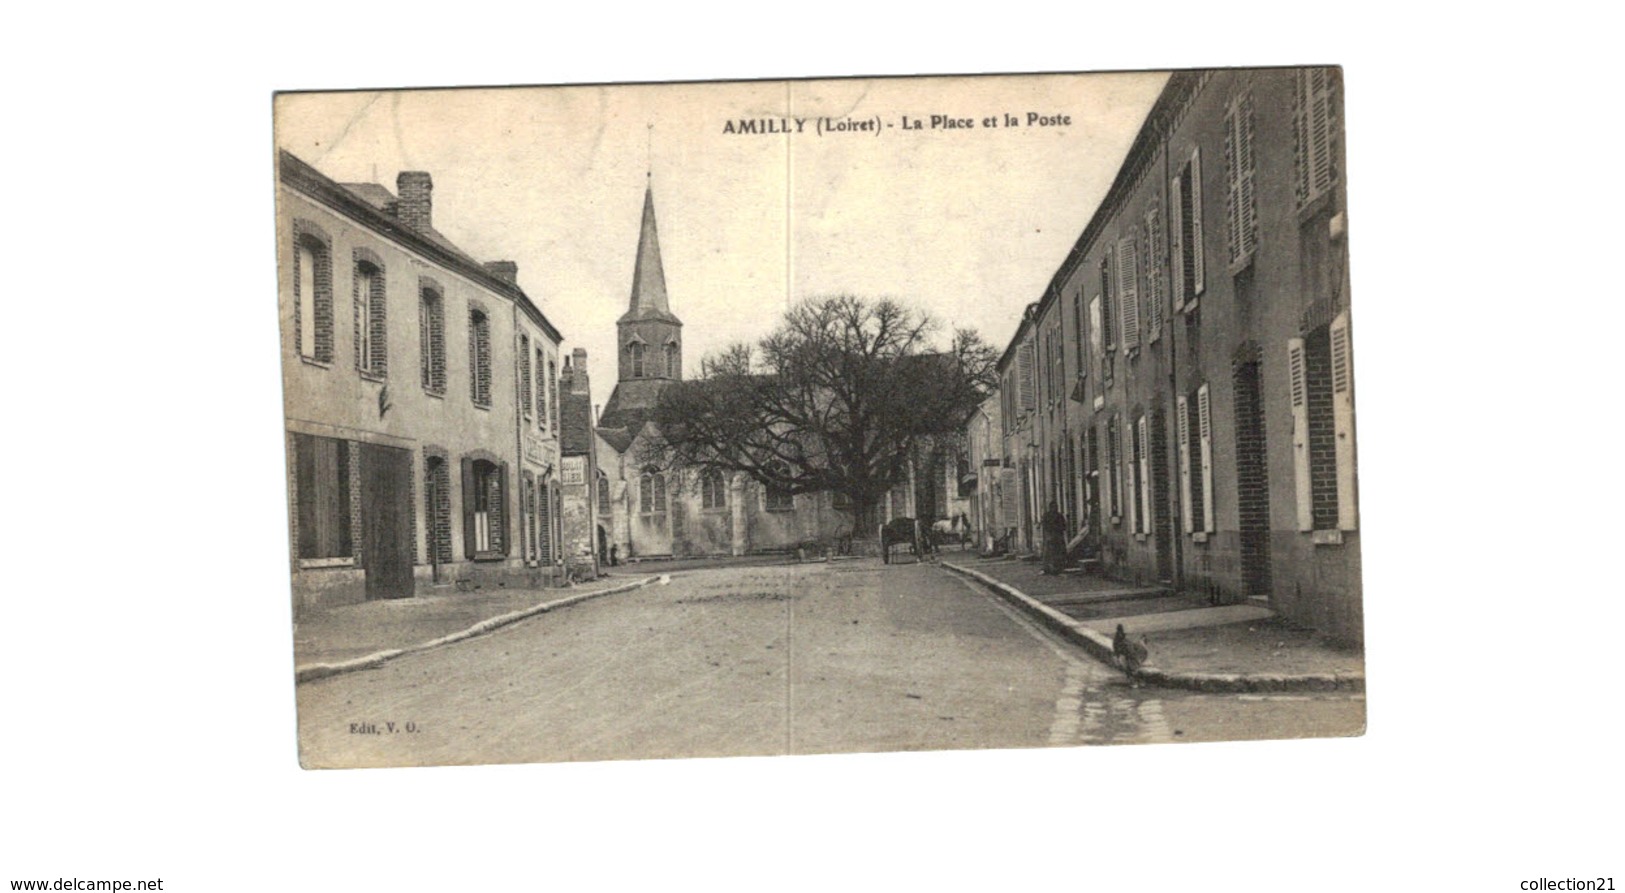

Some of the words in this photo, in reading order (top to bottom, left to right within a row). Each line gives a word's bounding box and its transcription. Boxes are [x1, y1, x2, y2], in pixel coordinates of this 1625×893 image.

[722, 118, 807, 135] AMILLY
[816, 115, 882, 138] (Loiret)
[901, 115, 924, 130] La
[930, 114, 975, 130] Place
[982, 115, 998, 129] et
[1004, 112, 1019, 128] la
[1026, 112, 1072, 127] Poste
[386, 721, 400, 734] V.
[405, 721, 421, 734] O.
